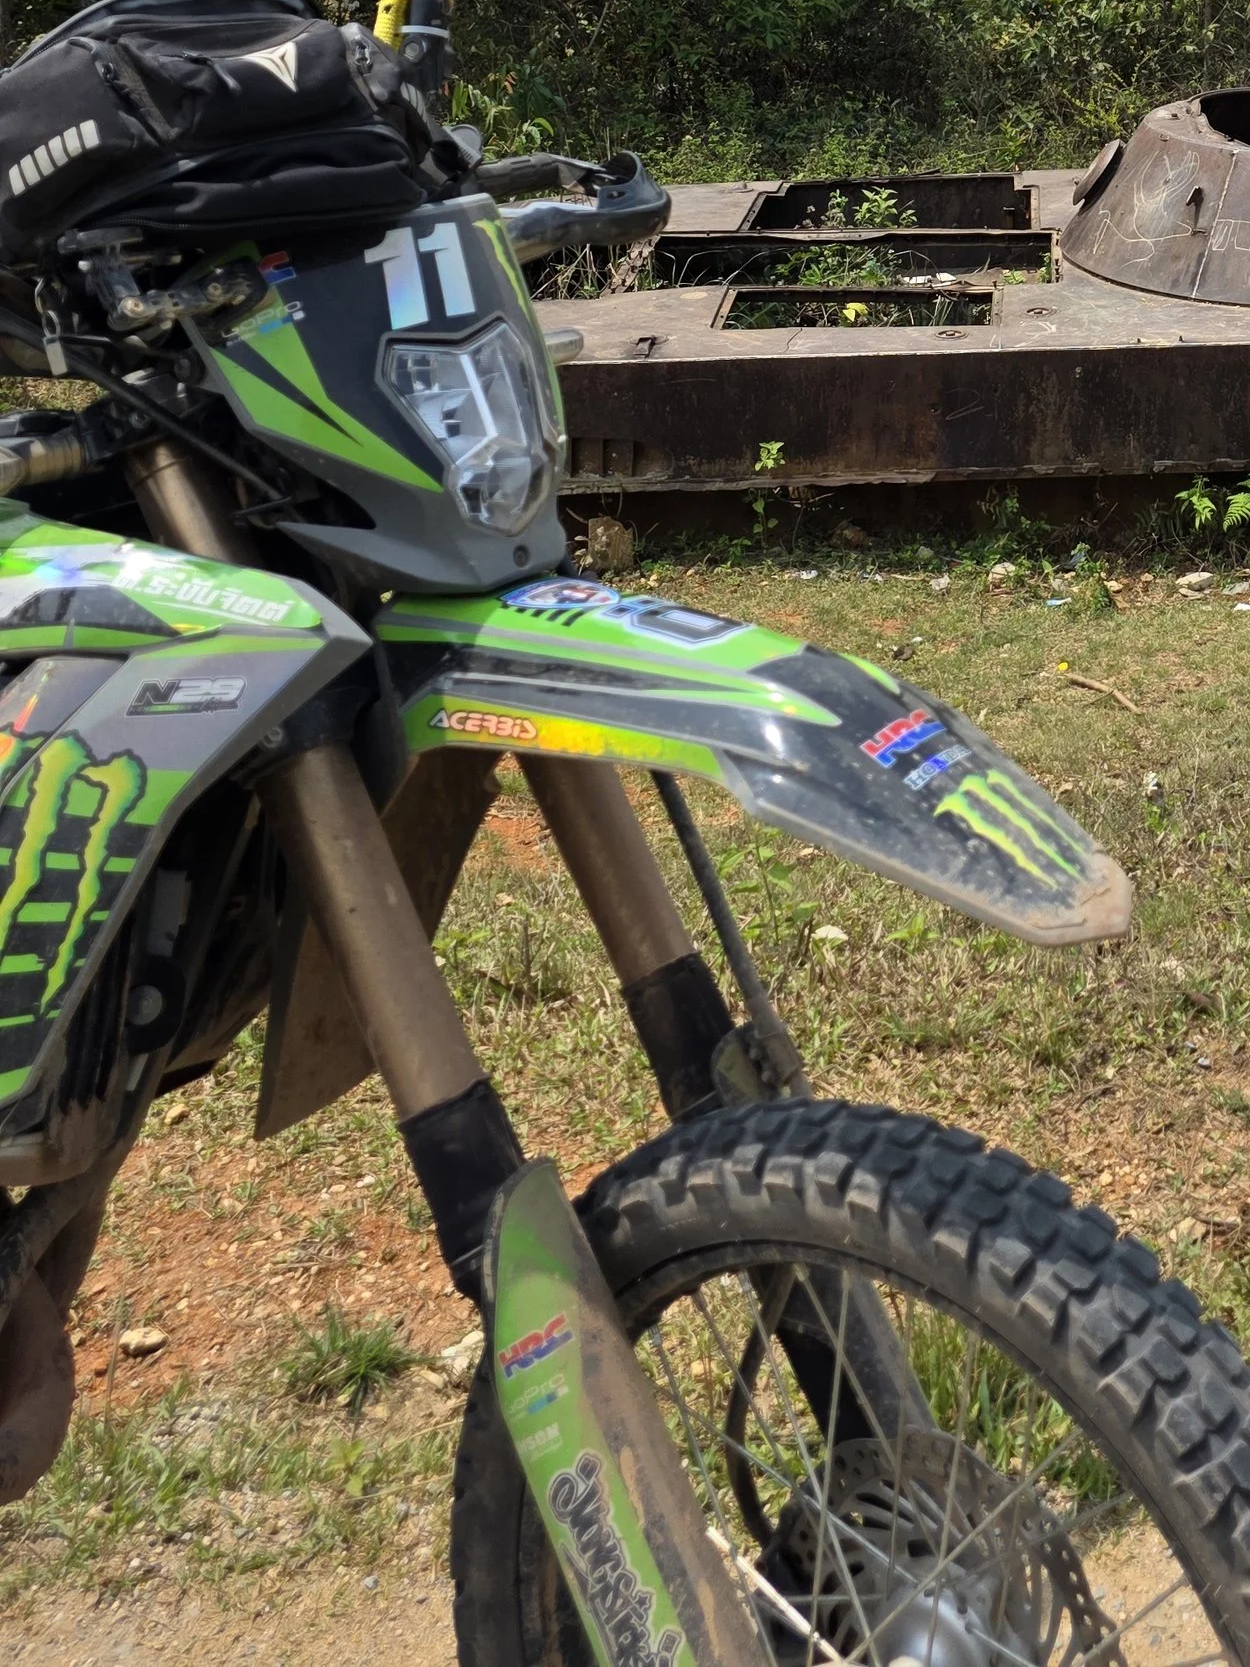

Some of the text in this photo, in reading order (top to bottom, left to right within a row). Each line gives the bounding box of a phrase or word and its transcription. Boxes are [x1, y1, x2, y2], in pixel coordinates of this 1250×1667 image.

[364, 222, 476, 330] 11
[860, 708, 946, 769] HRC
[498, 1311, 575, 1380] HRC
